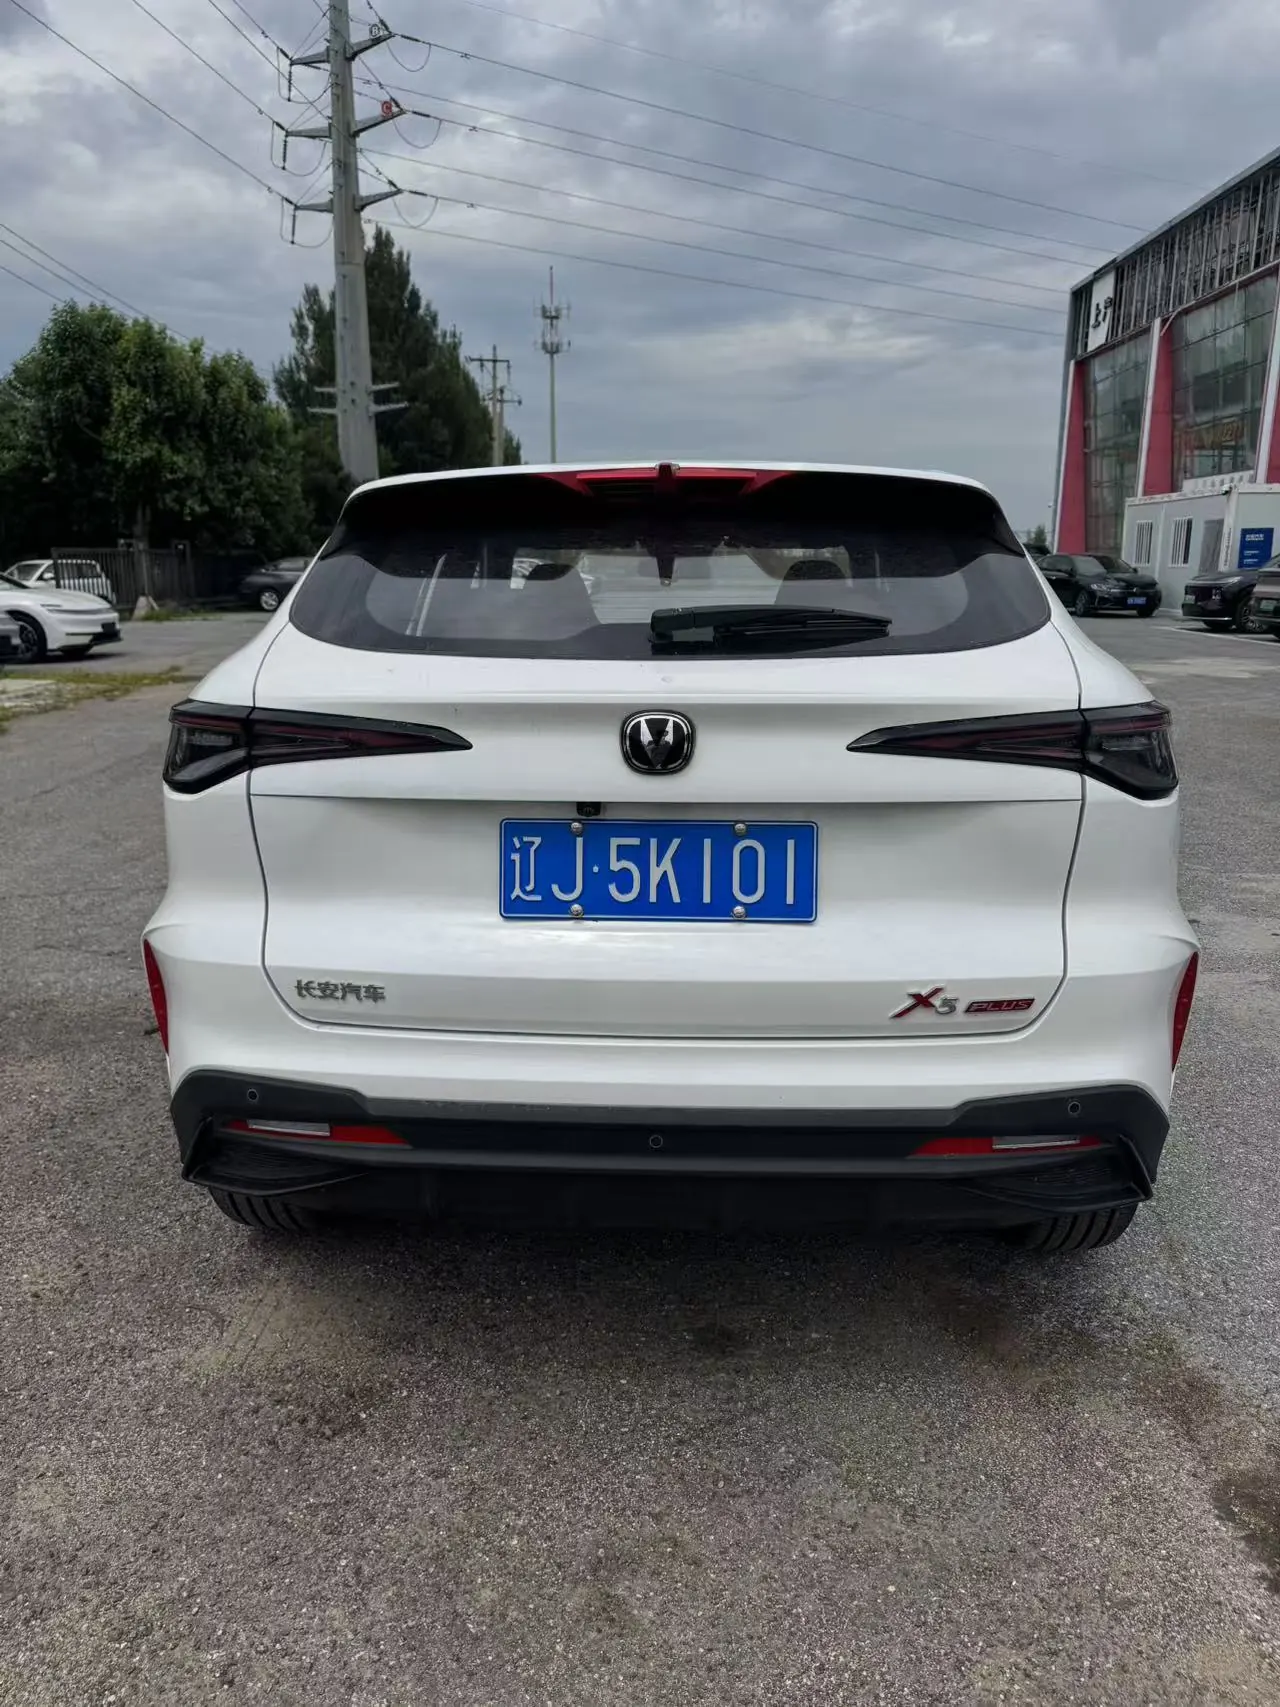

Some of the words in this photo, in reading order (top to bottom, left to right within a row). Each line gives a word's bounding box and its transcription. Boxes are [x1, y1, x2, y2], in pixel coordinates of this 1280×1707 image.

[295, 980, 386, 1003] 长安汽车
[890, 985, 959, 1019] X5
[967, 999, 1033, 1013] PLUS
